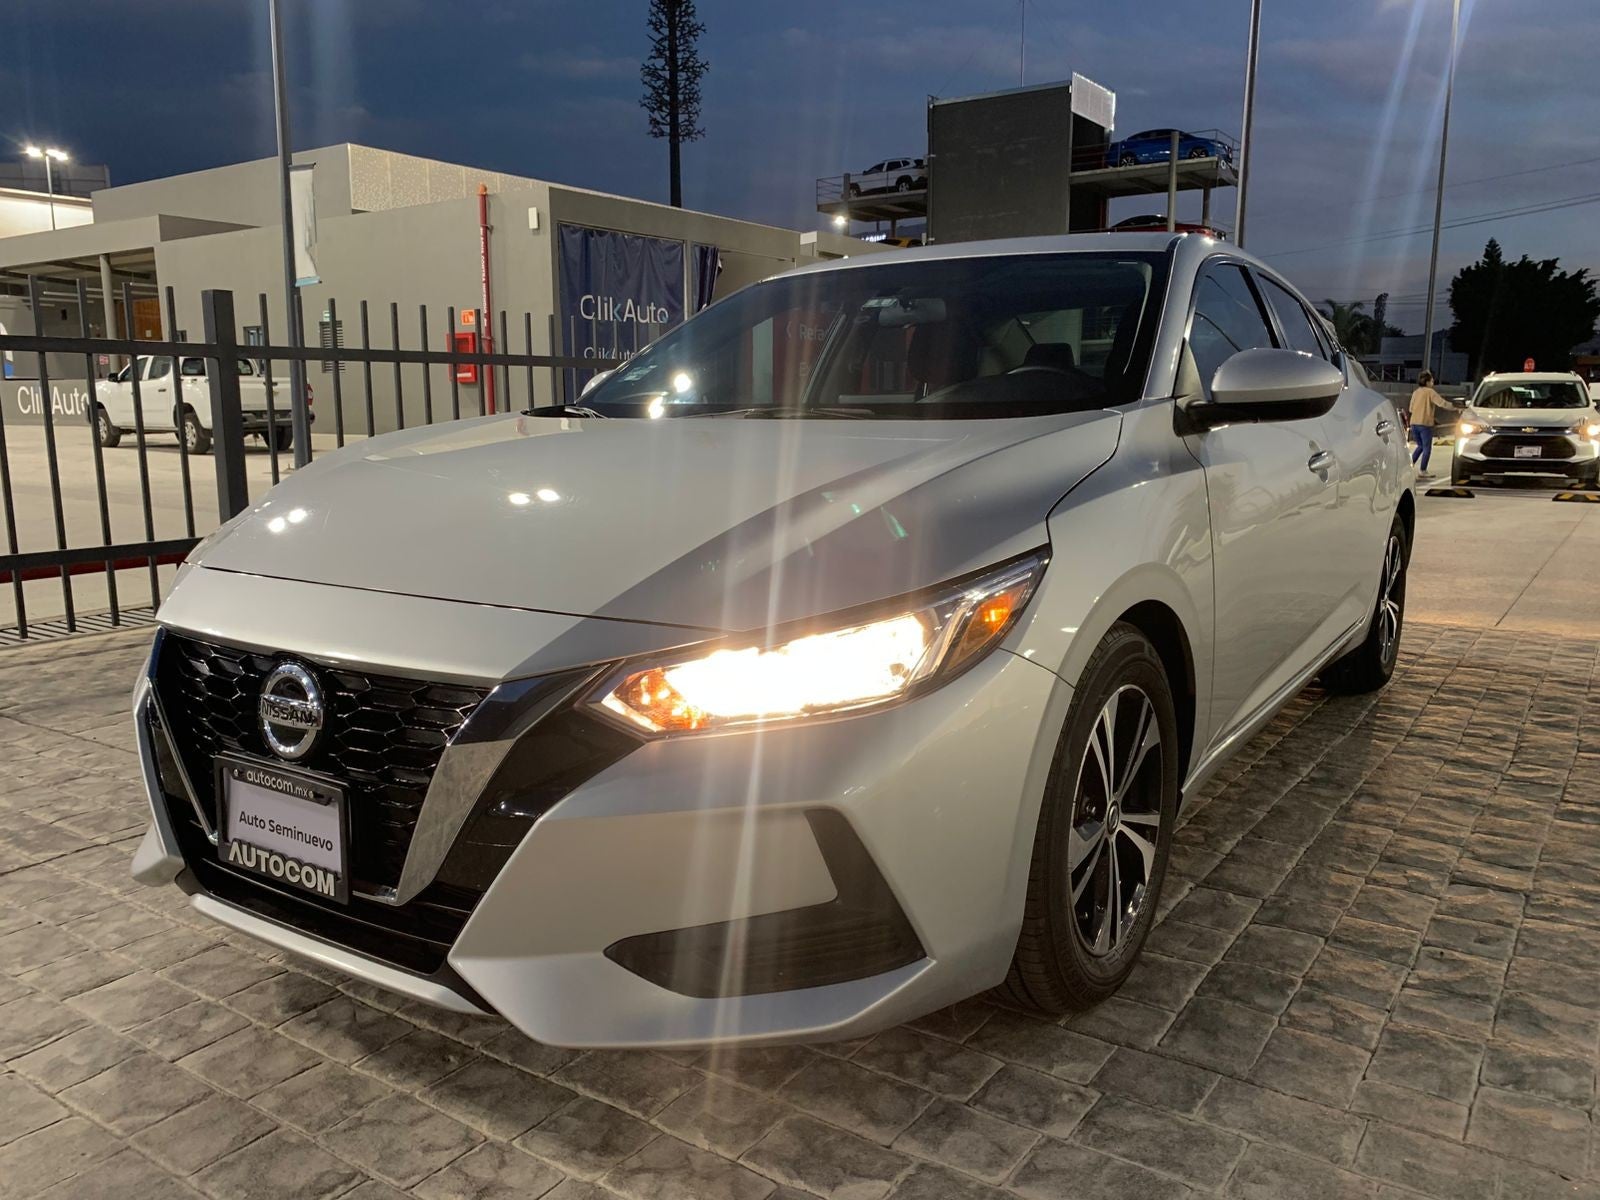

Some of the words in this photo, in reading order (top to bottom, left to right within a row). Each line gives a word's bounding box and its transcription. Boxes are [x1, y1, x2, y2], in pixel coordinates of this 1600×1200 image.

[580, 295, 669, 324] ClikAuto
[262, 698, 316, 726] NISSAN
[246, 770, 308, 798] autocom.mx
[239, 811, 266, 829] Auto
[268, 820, 333, 851] Seminuevo
[228, 841, 335, 896] AUTOCOM
